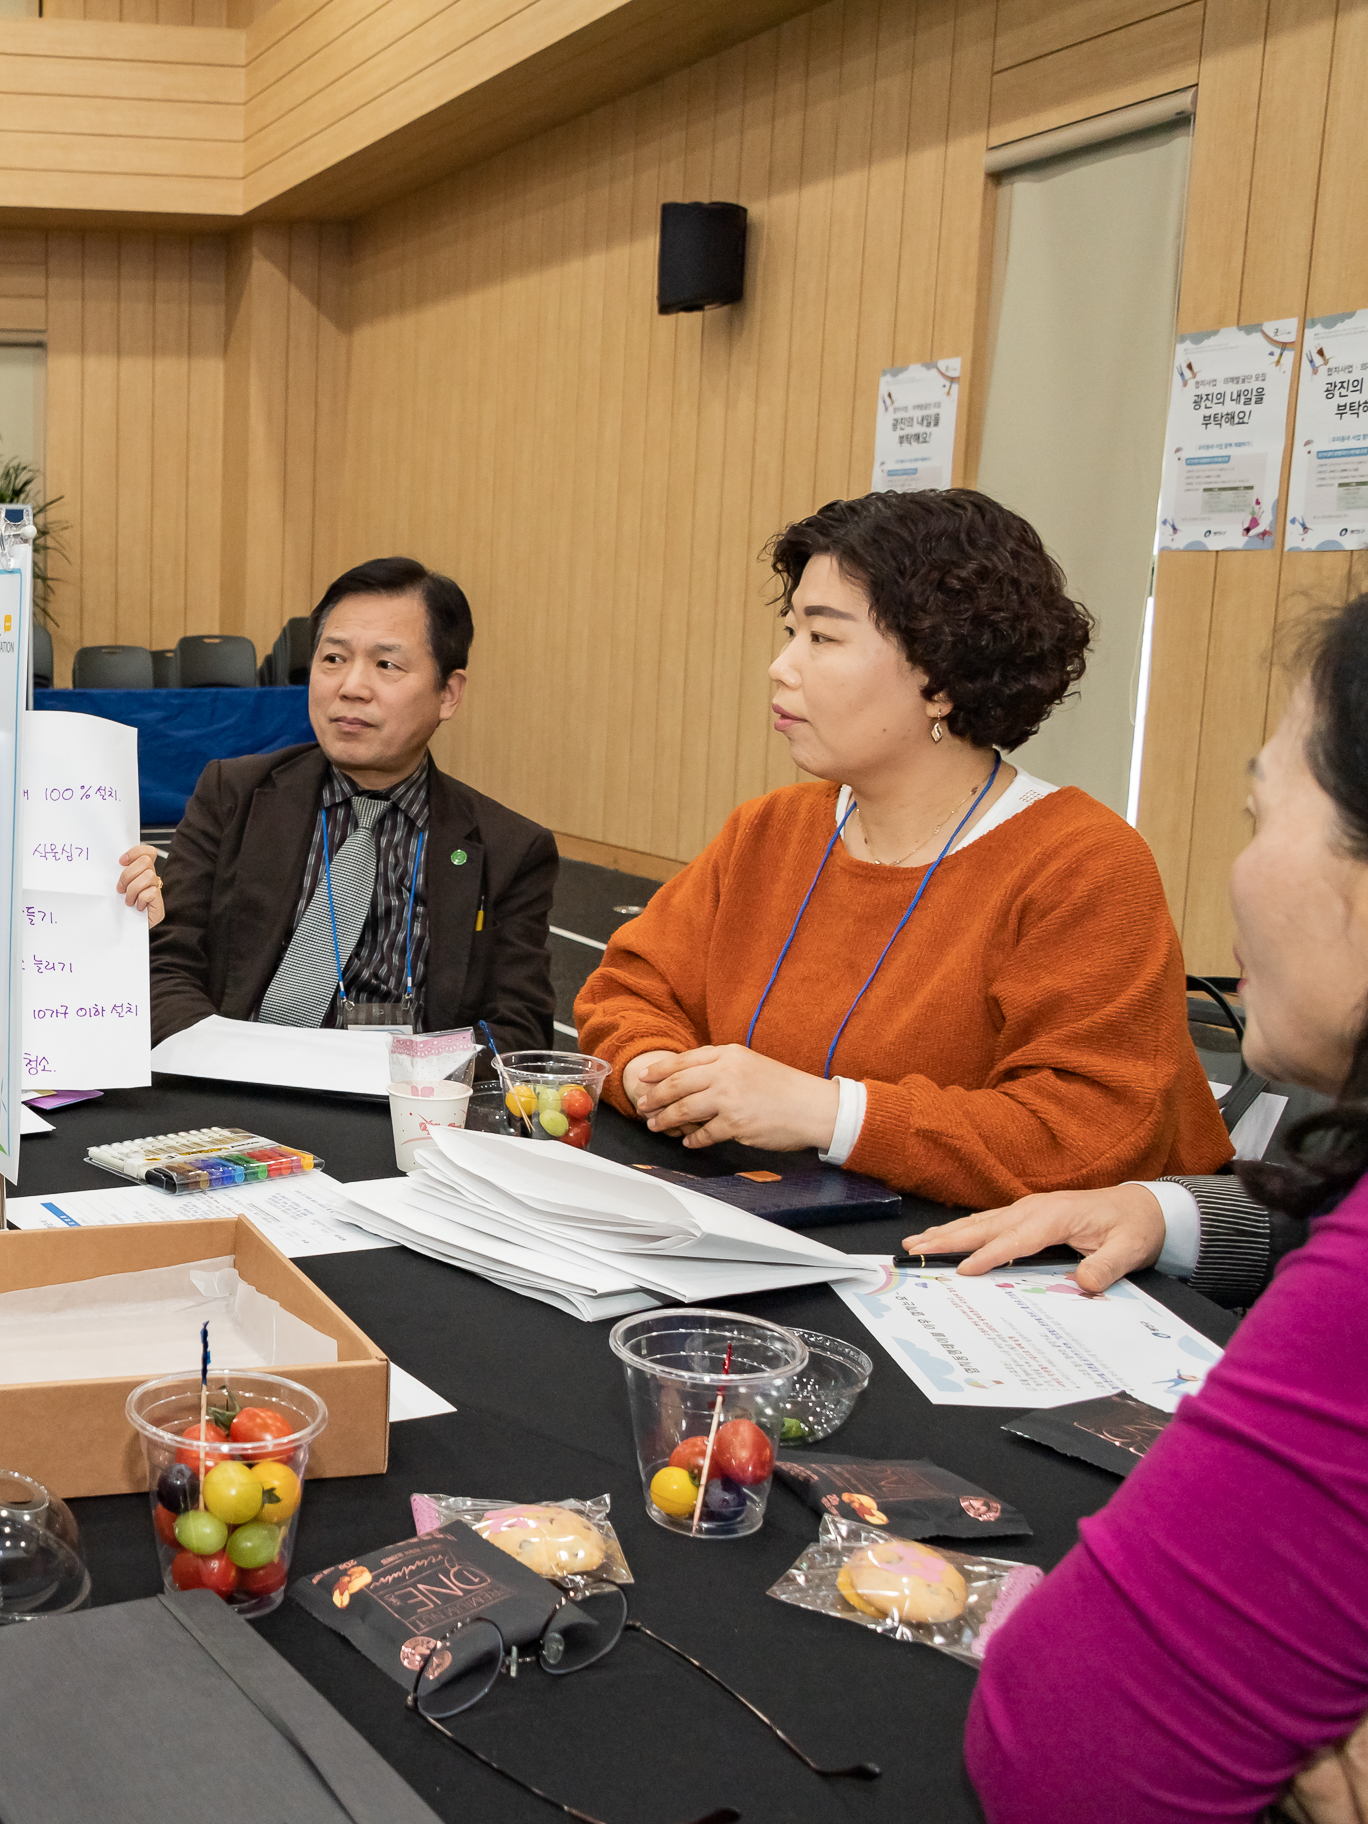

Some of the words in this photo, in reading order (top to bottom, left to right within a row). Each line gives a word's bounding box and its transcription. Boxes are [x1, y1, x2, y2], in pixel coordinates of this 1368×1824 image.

[1323, 377, 1364, 400] 광진의
[1192, 391, 1226, 411] 광진의
[1230, 387, 1265, 406] 내일을
[892, 416, 913, 432] 광진의
[916, 413, 940, 428] 내일을
[1201, 410, 1252, 430] 부탁해요!
[898, 431, 932, 447] 부탁해요!
[33, 954, 73, 974] 늘리기
[75, 1003, 106, 1018] 이하
[110, 1002, 138, 1018] 설치
